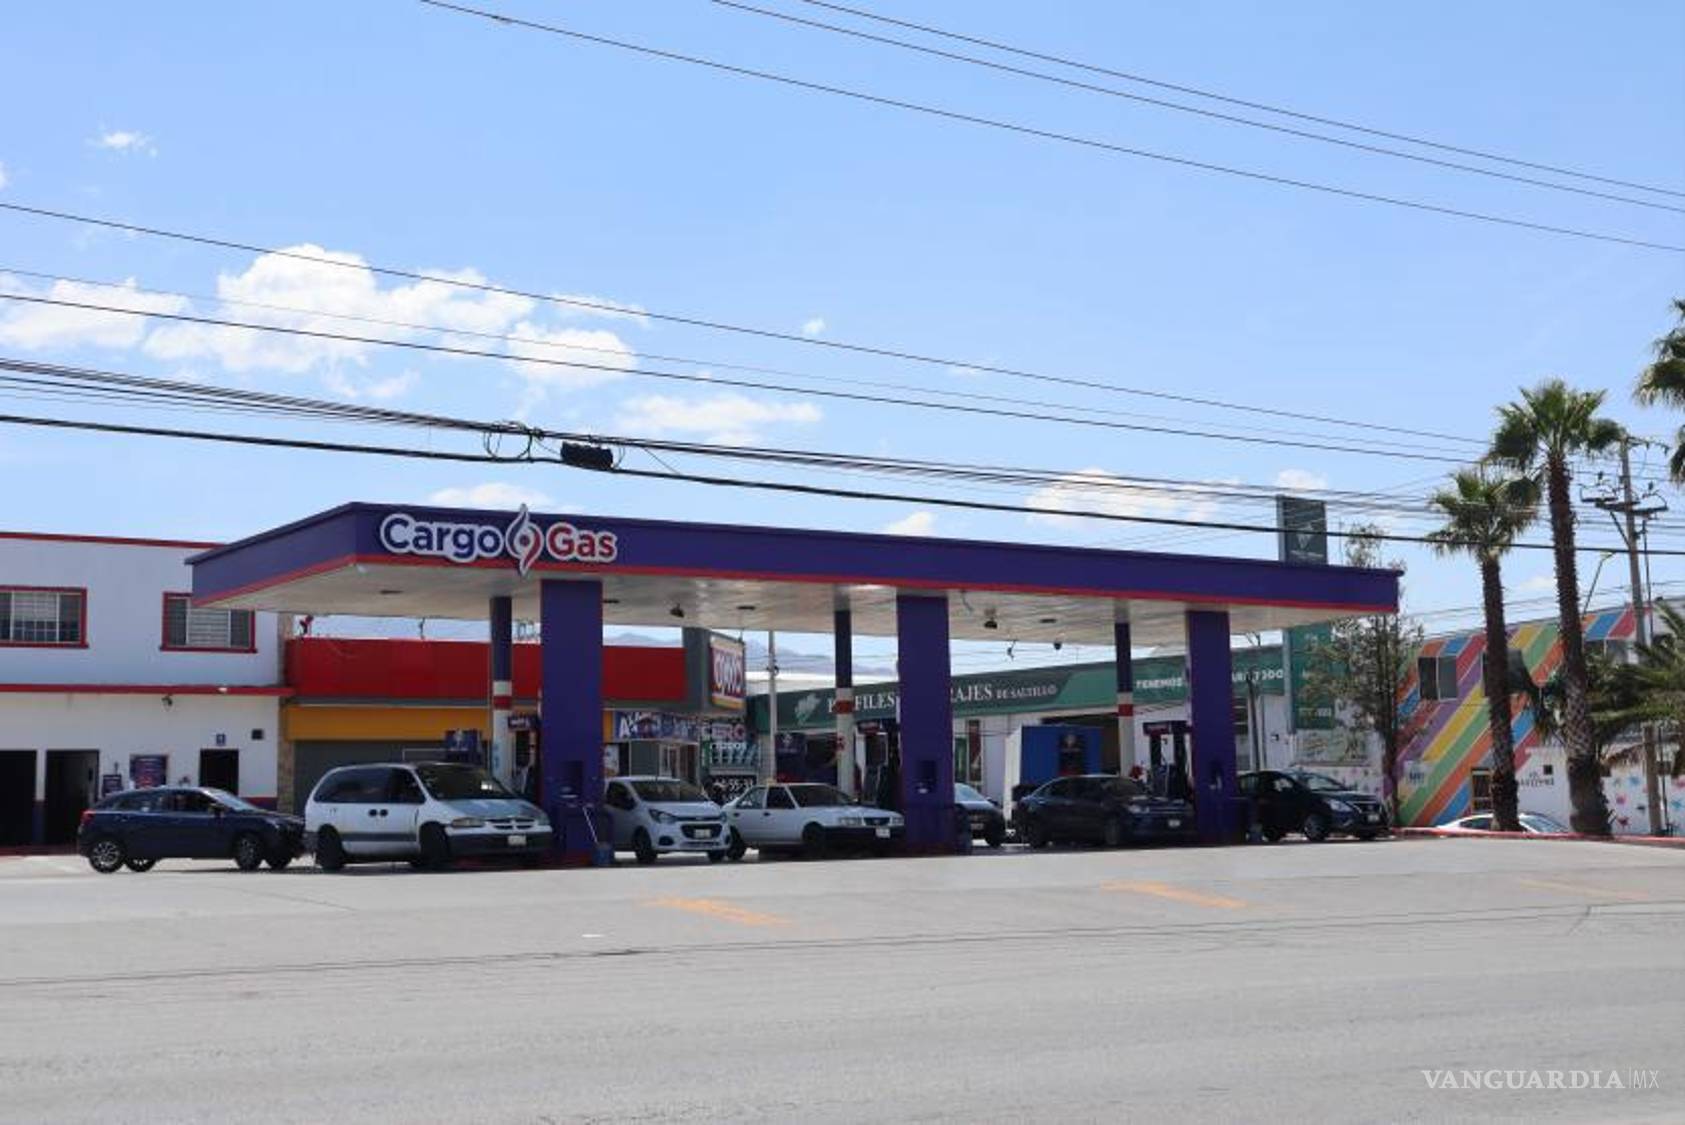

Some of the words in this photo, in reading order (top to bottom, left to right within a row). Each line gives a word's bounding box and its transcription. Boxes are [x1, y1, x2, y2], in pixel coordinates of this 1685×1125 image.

[381, 514, 503, 562] Cargo
[547, 523, 617, 561] Gas
[828, 692, 895, 712] PFILES
